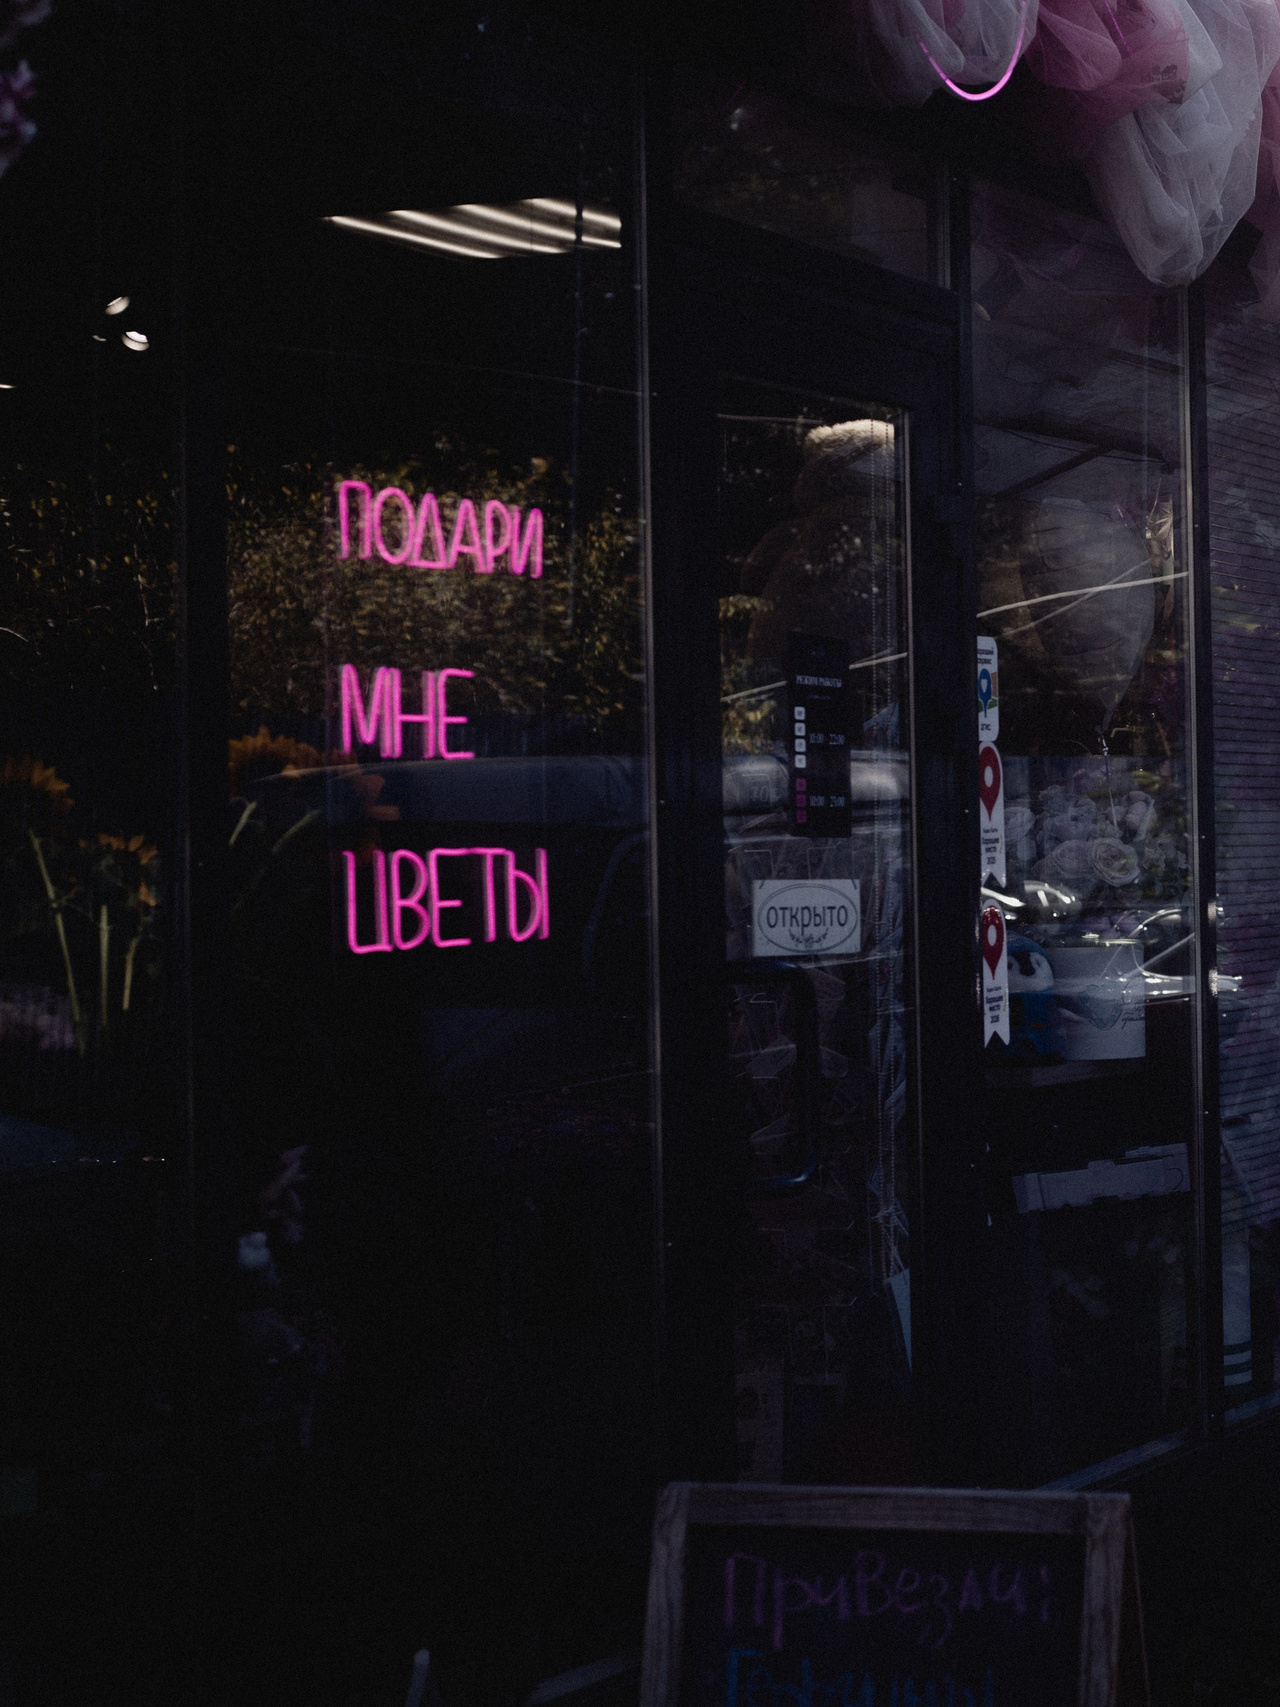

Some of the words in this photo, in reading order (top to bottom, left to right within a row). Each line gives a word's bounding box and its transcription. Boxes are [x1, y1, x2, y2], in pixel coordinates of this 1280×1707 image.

[338, 479, 545, 579] ПОДАРИ
[340, 662, 476, 760] МНЕ
[340, 846, 551, 955] ЦВЕТЫ
